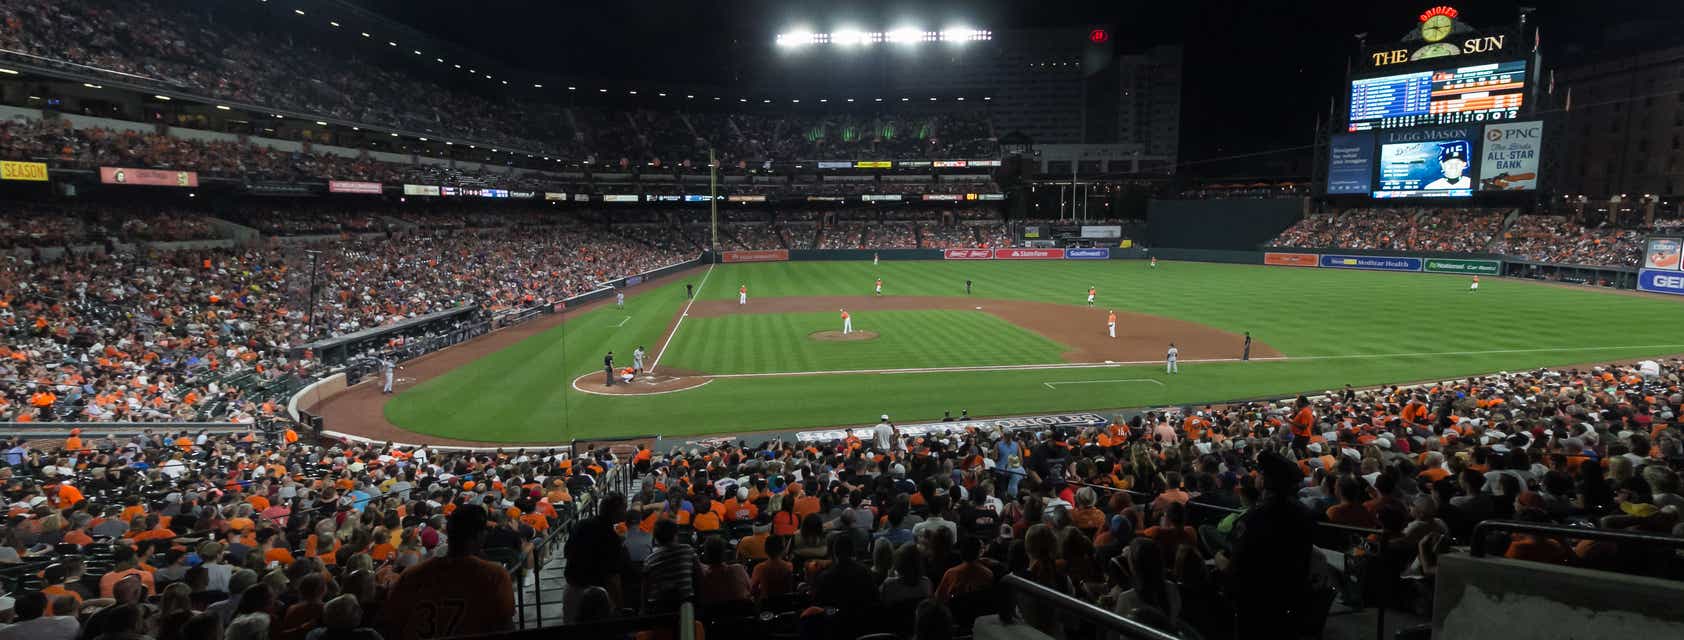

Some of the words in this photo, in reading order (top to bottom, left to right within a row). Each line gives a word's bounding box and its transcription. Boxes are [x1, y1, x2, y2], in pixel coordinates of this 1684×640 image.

[1419, 6, 1458, 23] ORIOLES
[1373, 49, 1408, 67] THE
[1463, 35, 1505, 54] SUN
[1390, 131, 1420, 141] LEGG
[1423, 129, 1467, 140] MASON
[1505, 127, 1540, 139] PNC
[1487, 150, 1535, 161] ALL-STAR
[4, 160, 46, 178] SEASON
[1496, 160, 1522, 170] BANK
